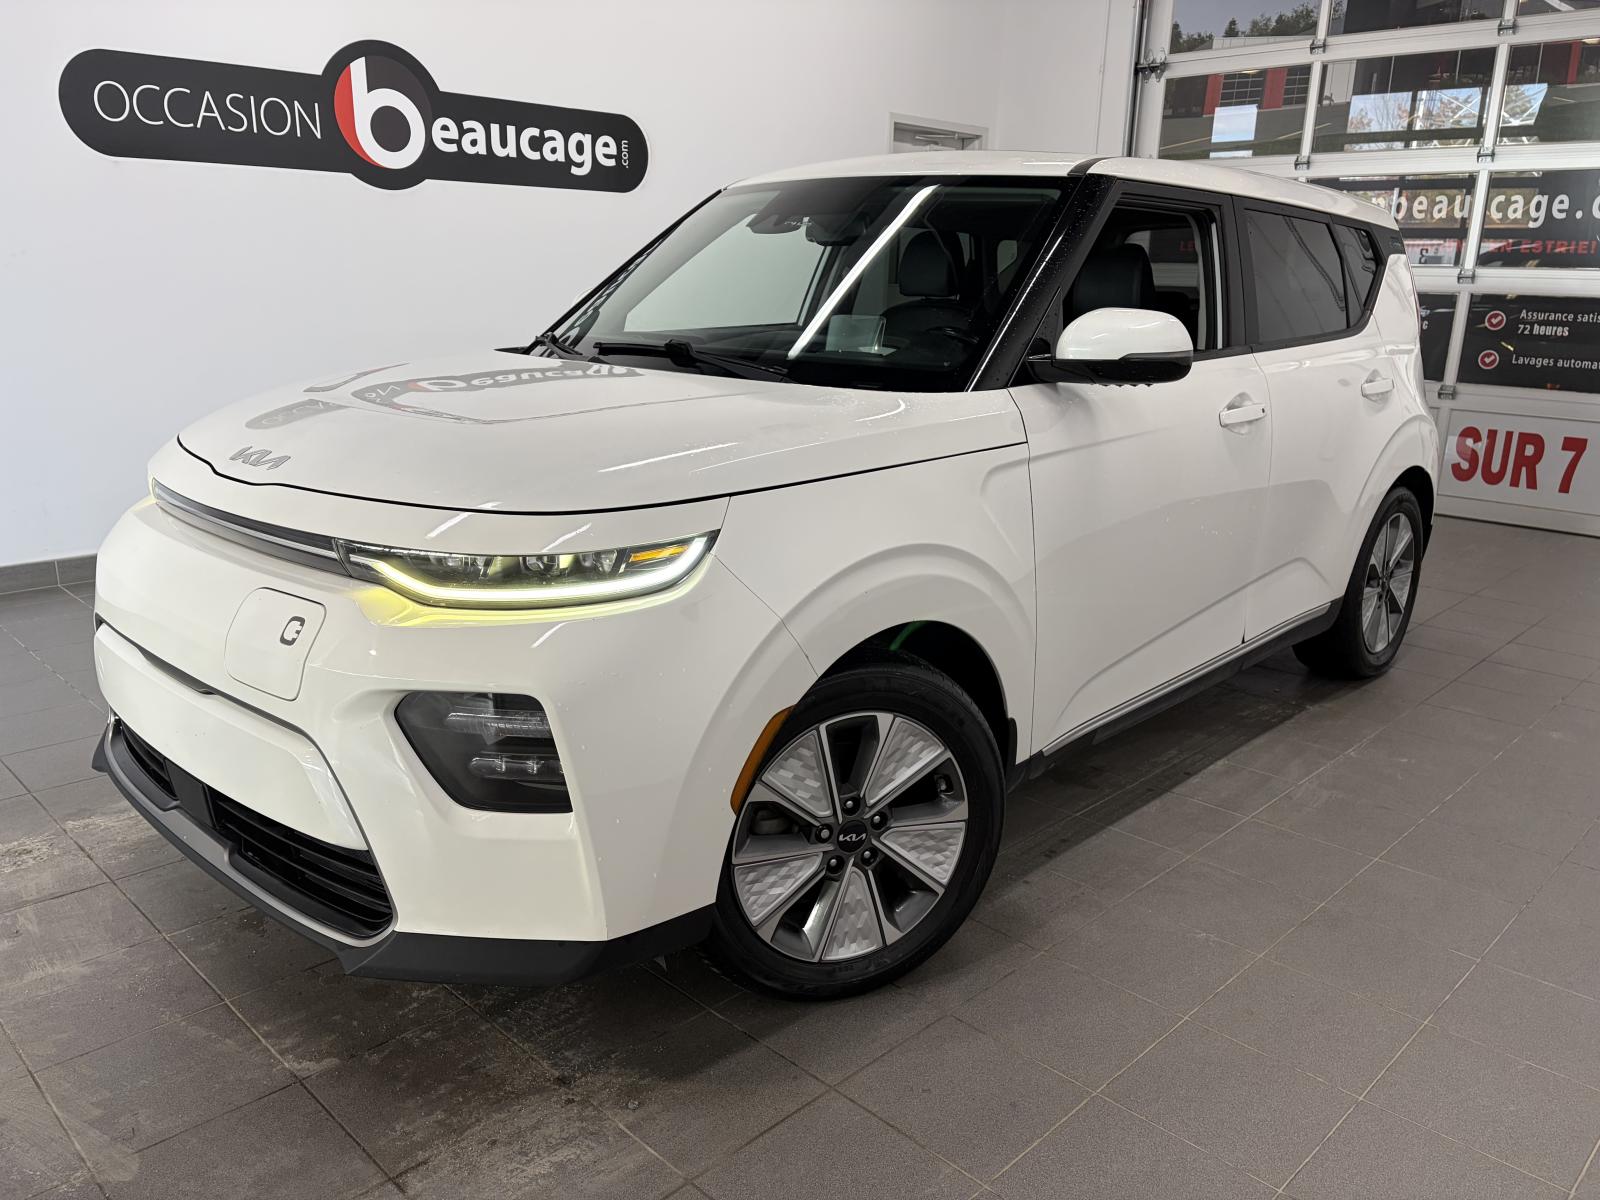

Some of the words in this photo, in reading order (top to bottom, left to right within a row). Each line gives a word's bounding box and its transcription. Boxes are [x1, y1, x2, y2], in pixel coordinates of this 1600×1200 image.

[93, 80, 321, 139] OCCASION
[349, 56, 618, 176] beaucage
[620, 140, 629, 169] .com
[1520, 309, 1574, 322] Assurance
[1518, 324, 1531, 335] 72
[1533, 323, 1569, 337] heures
[1512, 354, 1554, 368] Lavages
[1451, 426, 1546, 491] SUR
[1558, 436, 1588, 494] 7
